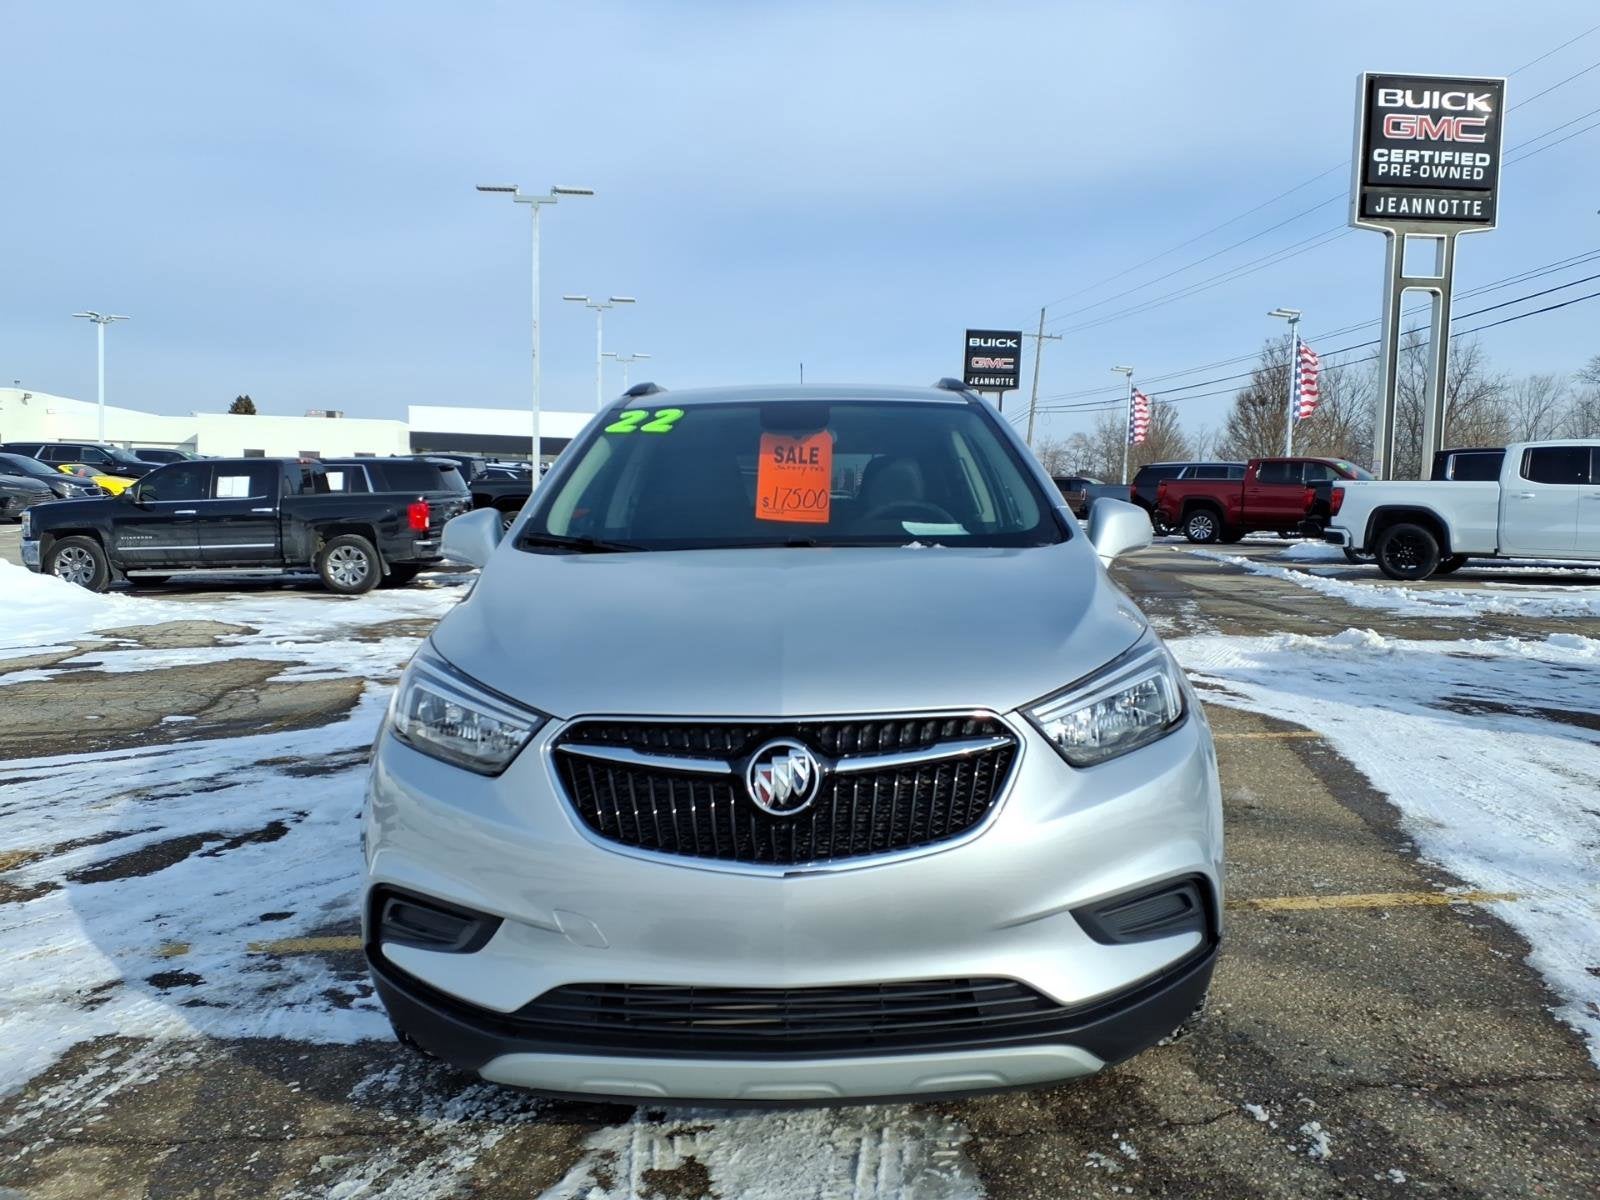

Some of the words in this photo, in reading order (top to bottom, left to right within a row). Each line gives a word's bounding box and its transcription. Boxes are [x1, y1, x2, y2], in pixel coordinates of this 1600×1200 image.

[1378, 88, 1492, 112] BUICK
[1383, 113, 1489, 143] GMC
[1373, 148, 1490, 166] CERTIFIED
[1378, 164, 1484, 180] PRE-OWNED
[1375, 197, 1482, 216] JEANNOTTE
[969, 337, 1018, 348] BUICK
[971, 356, 1015, 369] GMC
[969, 376, 1015, 386] JEANNOTTE
[604, 408, 685, 433] 22
[774, 445, 820, 465] SALE
